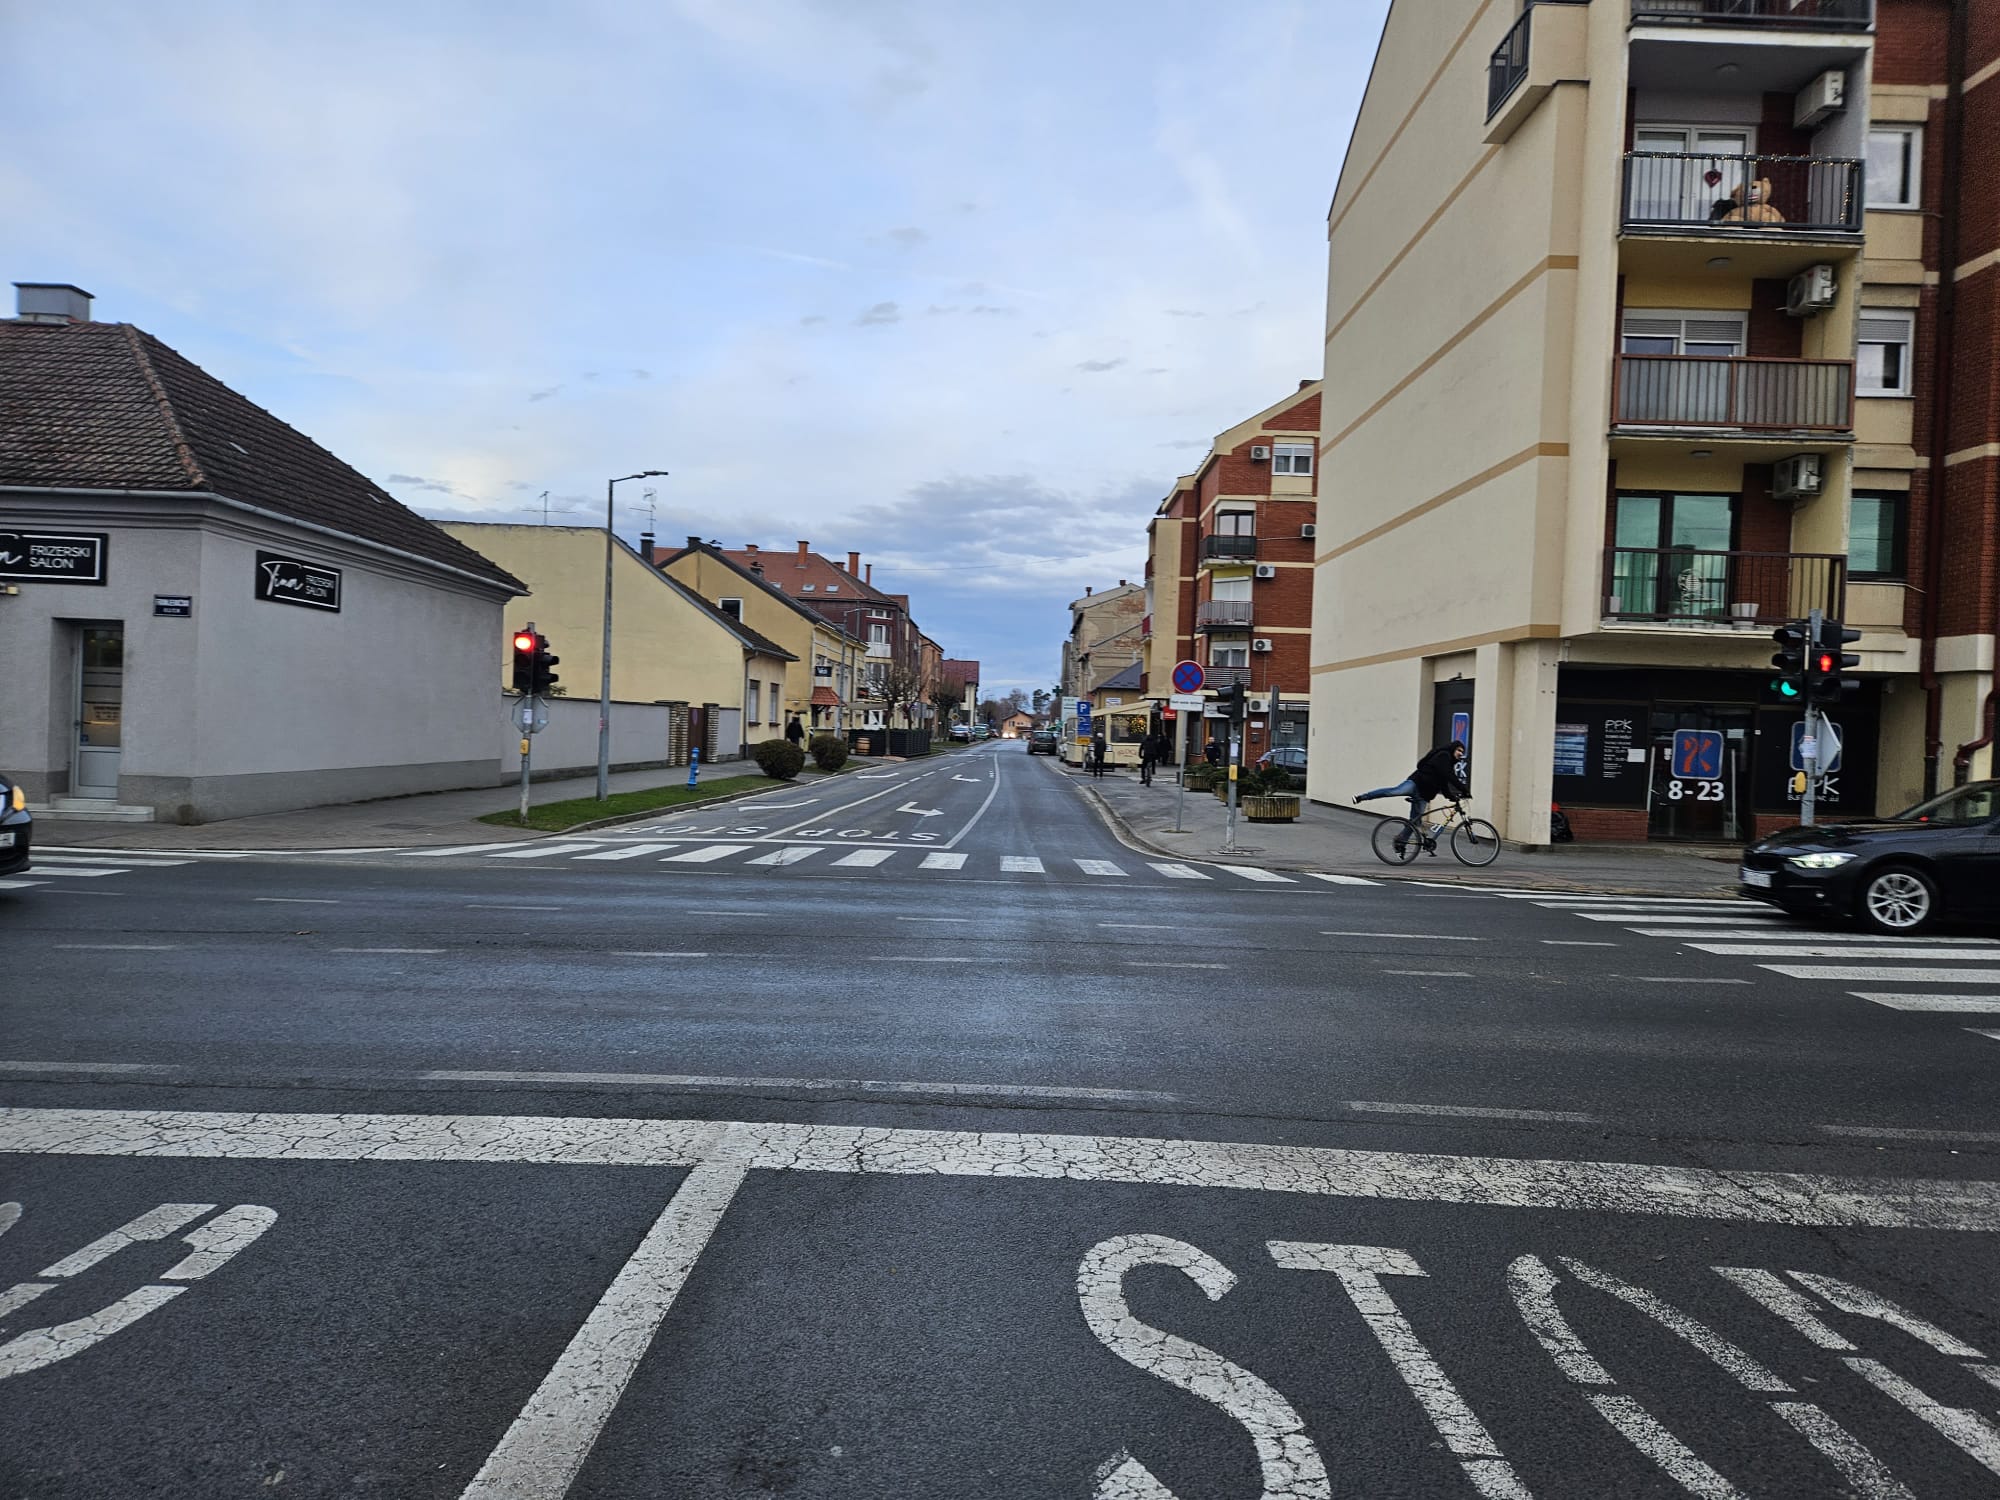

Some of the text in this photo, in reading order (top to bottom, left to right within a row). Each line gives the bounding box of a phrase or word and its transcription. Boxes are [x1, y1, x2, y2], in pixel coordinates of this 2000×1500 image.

[29, 545, 91, 557] FRIZERSKI
[29, 557, 74, 569] SALON
[305, 585, 328, 598] SALON
[796, 828, 941, 842] STOP
